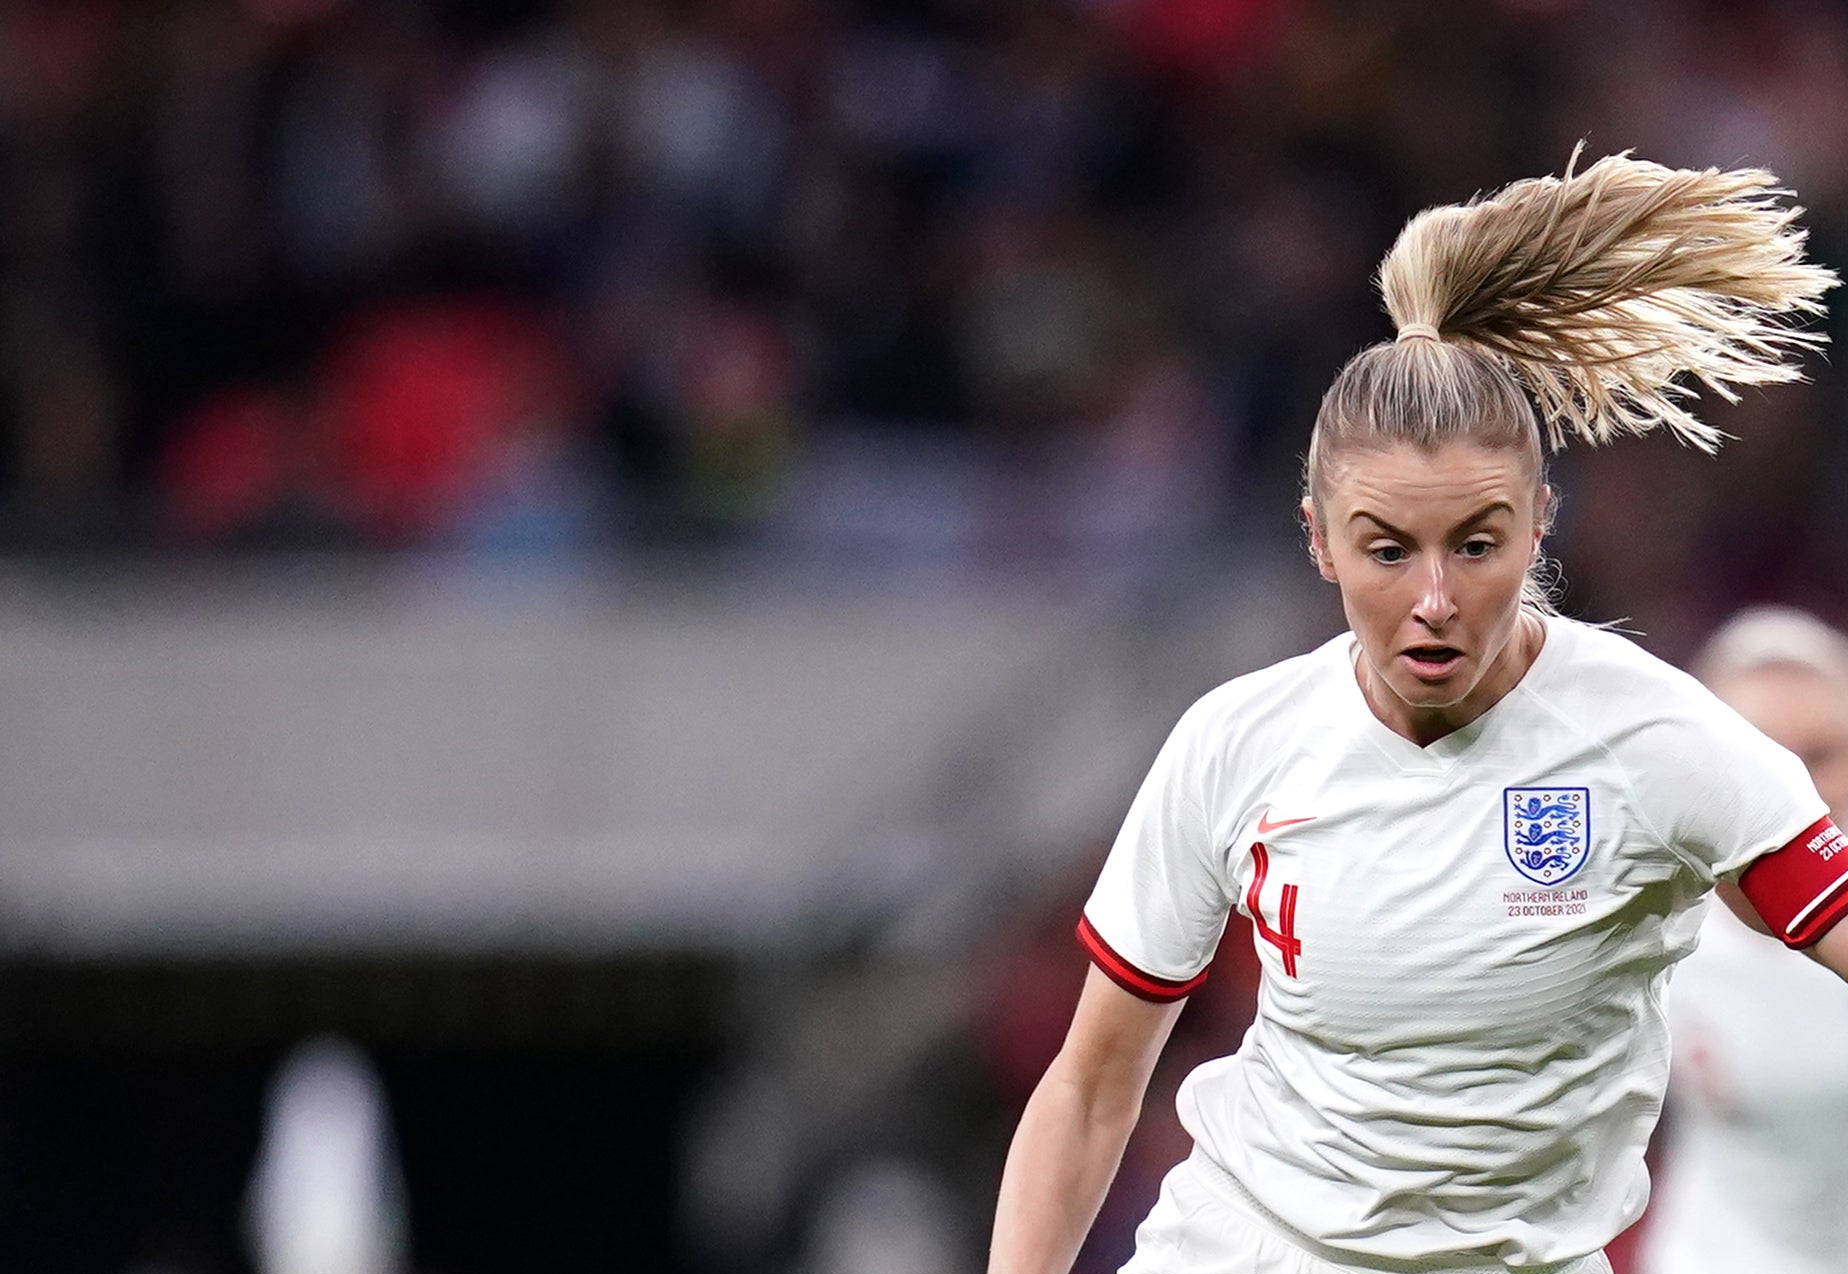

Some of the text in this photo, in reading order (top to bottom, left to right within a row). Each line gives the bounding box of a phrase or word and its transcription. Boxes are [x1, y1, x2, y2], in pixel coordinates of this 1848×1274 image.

[1503, 890, 1588, 903] NORTHERN IRELAND
[1247, 842, 1302, 979] 4
[1508, 903, 1587, 917] 23 OCTOBER 2021
